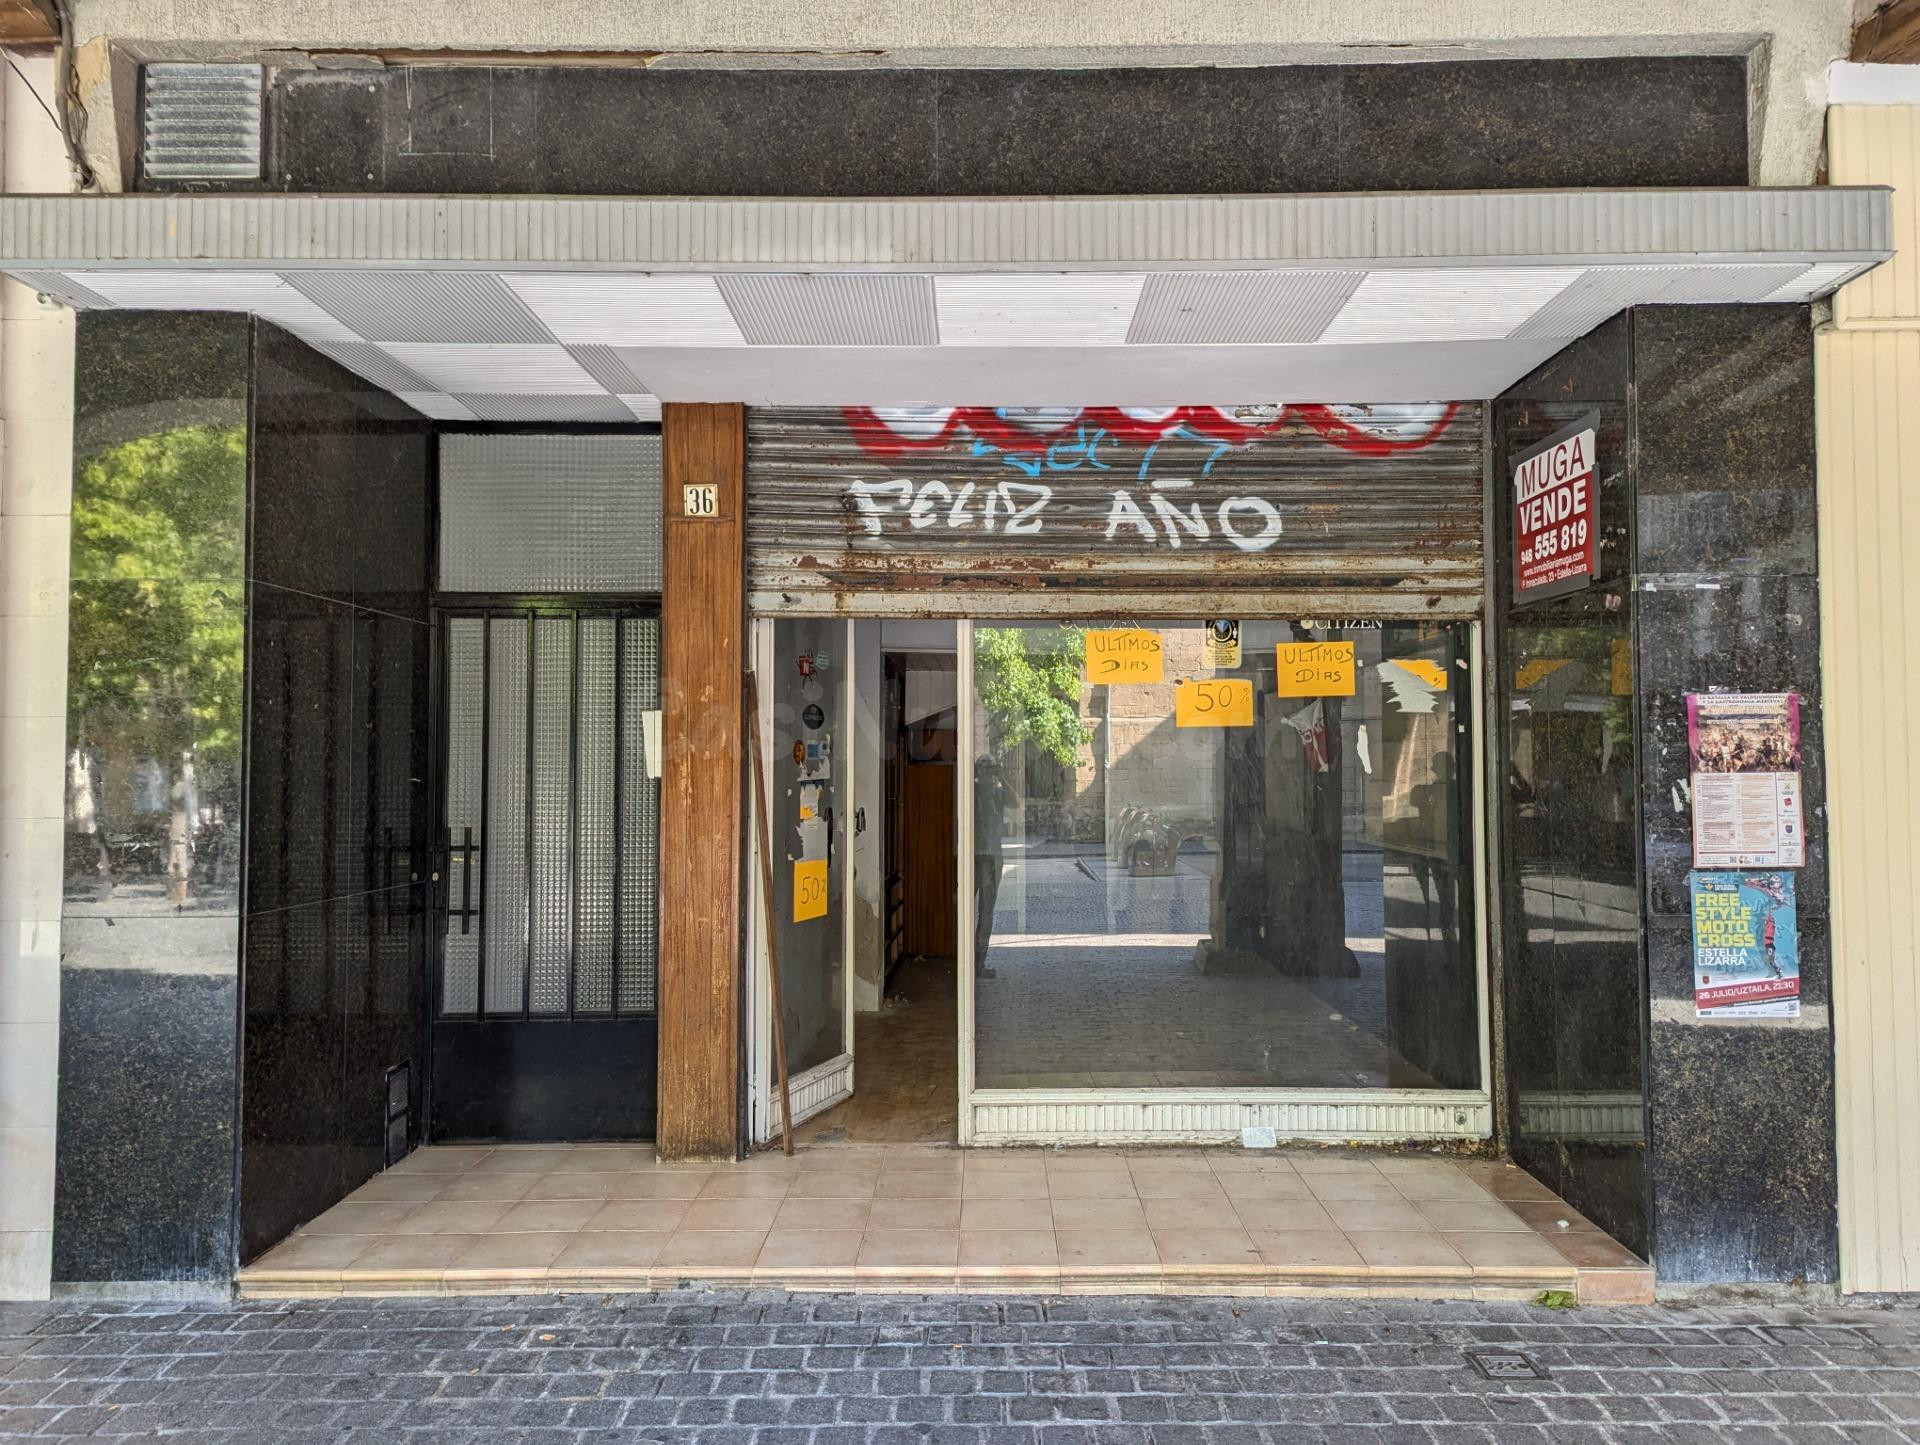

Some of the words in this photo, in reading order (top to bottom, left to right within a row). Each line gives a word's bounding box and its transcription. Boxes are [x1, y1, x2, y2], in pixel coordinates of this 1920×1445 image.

[1521, 436, 1585, 498] MUGA
[689, 488, 713, 514] 36
[1519, 478, 1587, 536] VENDE
[851, 479, 1053, 535] FELIZ
[1105, 478, 1283, 551] AÑO
[1535, 529, 1558, 560] 555
[1561, 518, 1587, 551] 819
[1315, 619, 1383, 630] CITIZEN
[1094, 633, 1160, 653] ULTIMOS
[1284, 644, 1354, 664] ULTIMOS
[1695, 893, 1740, 907] FREE
[1695, 906, 1753, 920] STYLE
[1696, 920, 1749, 934] MOTO
[1697, 933, 1756, 947] CROSS
[1698, 947, 1748, 957] ESTELLA
[1698, 956, 1746, 966] LIZARRA
[1698, 991, 1710, 999] 26
